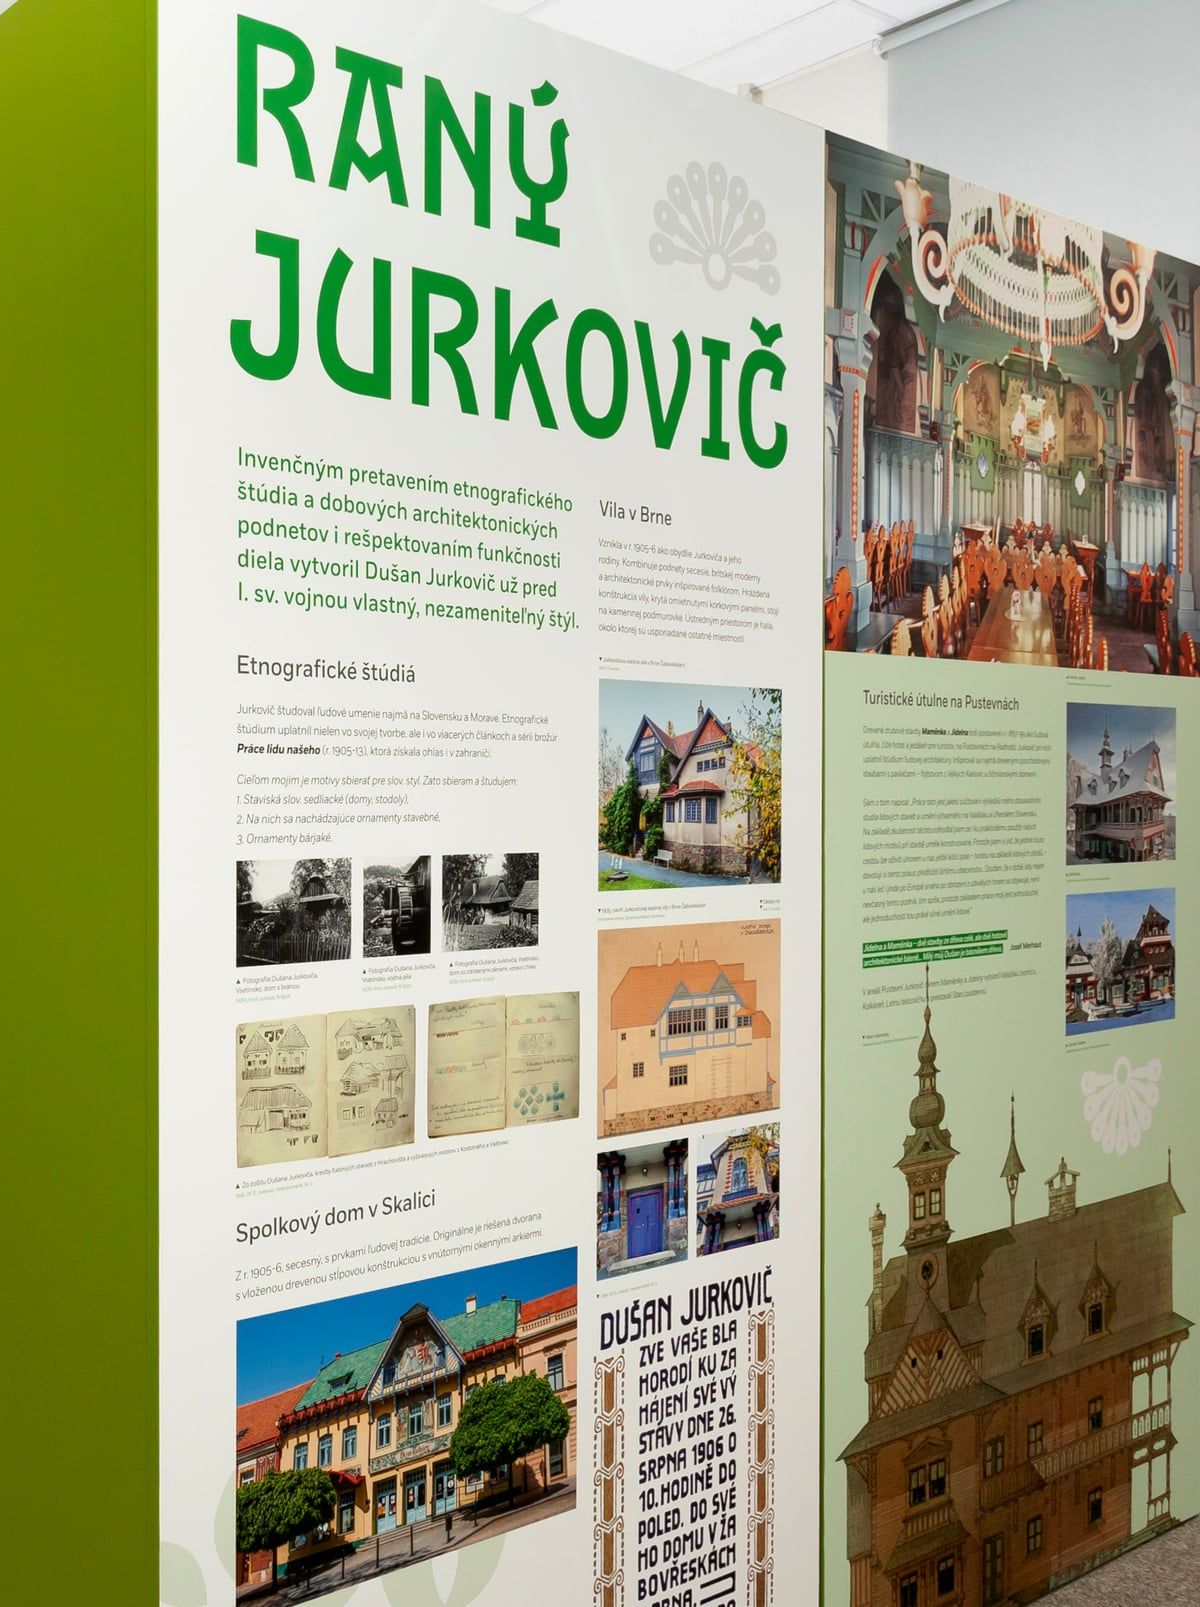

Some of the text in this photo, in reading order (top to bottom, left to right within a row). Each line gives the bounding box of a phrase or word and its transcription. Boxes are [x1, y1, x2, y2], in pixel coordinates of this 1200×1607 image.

[236, 13, 570, 249] RANÝ
[229, 228, 788, 470] JURKOVIČ
[238, 446, 573, 512] Invenčným pretavením etnografického
[237, 479, 558, 540] štúdia a dobových architektonických
[599, 499, 672, 526] Vila v Brne
[238, 517, 561, 569] podnetov i rešpektovaním funkčnosti
[237, 548, 557, 599] diela vytvoril Dušan Jurkovič už pred
[254, 587, 278, 604] sv.
[284, 587, 348, 612] vojnou
[352, 592, 420, 620] vlastný,
[424, 602, 545, 631] nezameniteľný
[549, 609, 580, 633] štýl.
[237, 654, 416, 683] Etnografické štúdiá
[862, 689, 1020, 711] Turistické útulne na Pustevnách
[236, 1188, 436, 1246] Spolkový dom v Skalici
[600, 1264, 772, 1351] DUŠAN JURKOVIČ
[639, 1320, 737, 1368] ZVE VAŠE BLA
[639, 1347, 737, 1398] HORODÍ KU ZA
[639, 1371, 737, 1426] HÁJENÍ SVÉ VÝ
[638, 1403, 737, 1455] STAVY DNE 26.
[638, 1432, 737, 1484] SRPNA 1906 O
[638, 1459, 737, 1513] 10. HODINĚ DO
[638, 1482, 737, 1545] POLED. DO SVÉ
[638, 1513, 737, 1573] HO DOMU V ŽA
[637, 1542, 736, 1601] BOVŘESKÁCH
